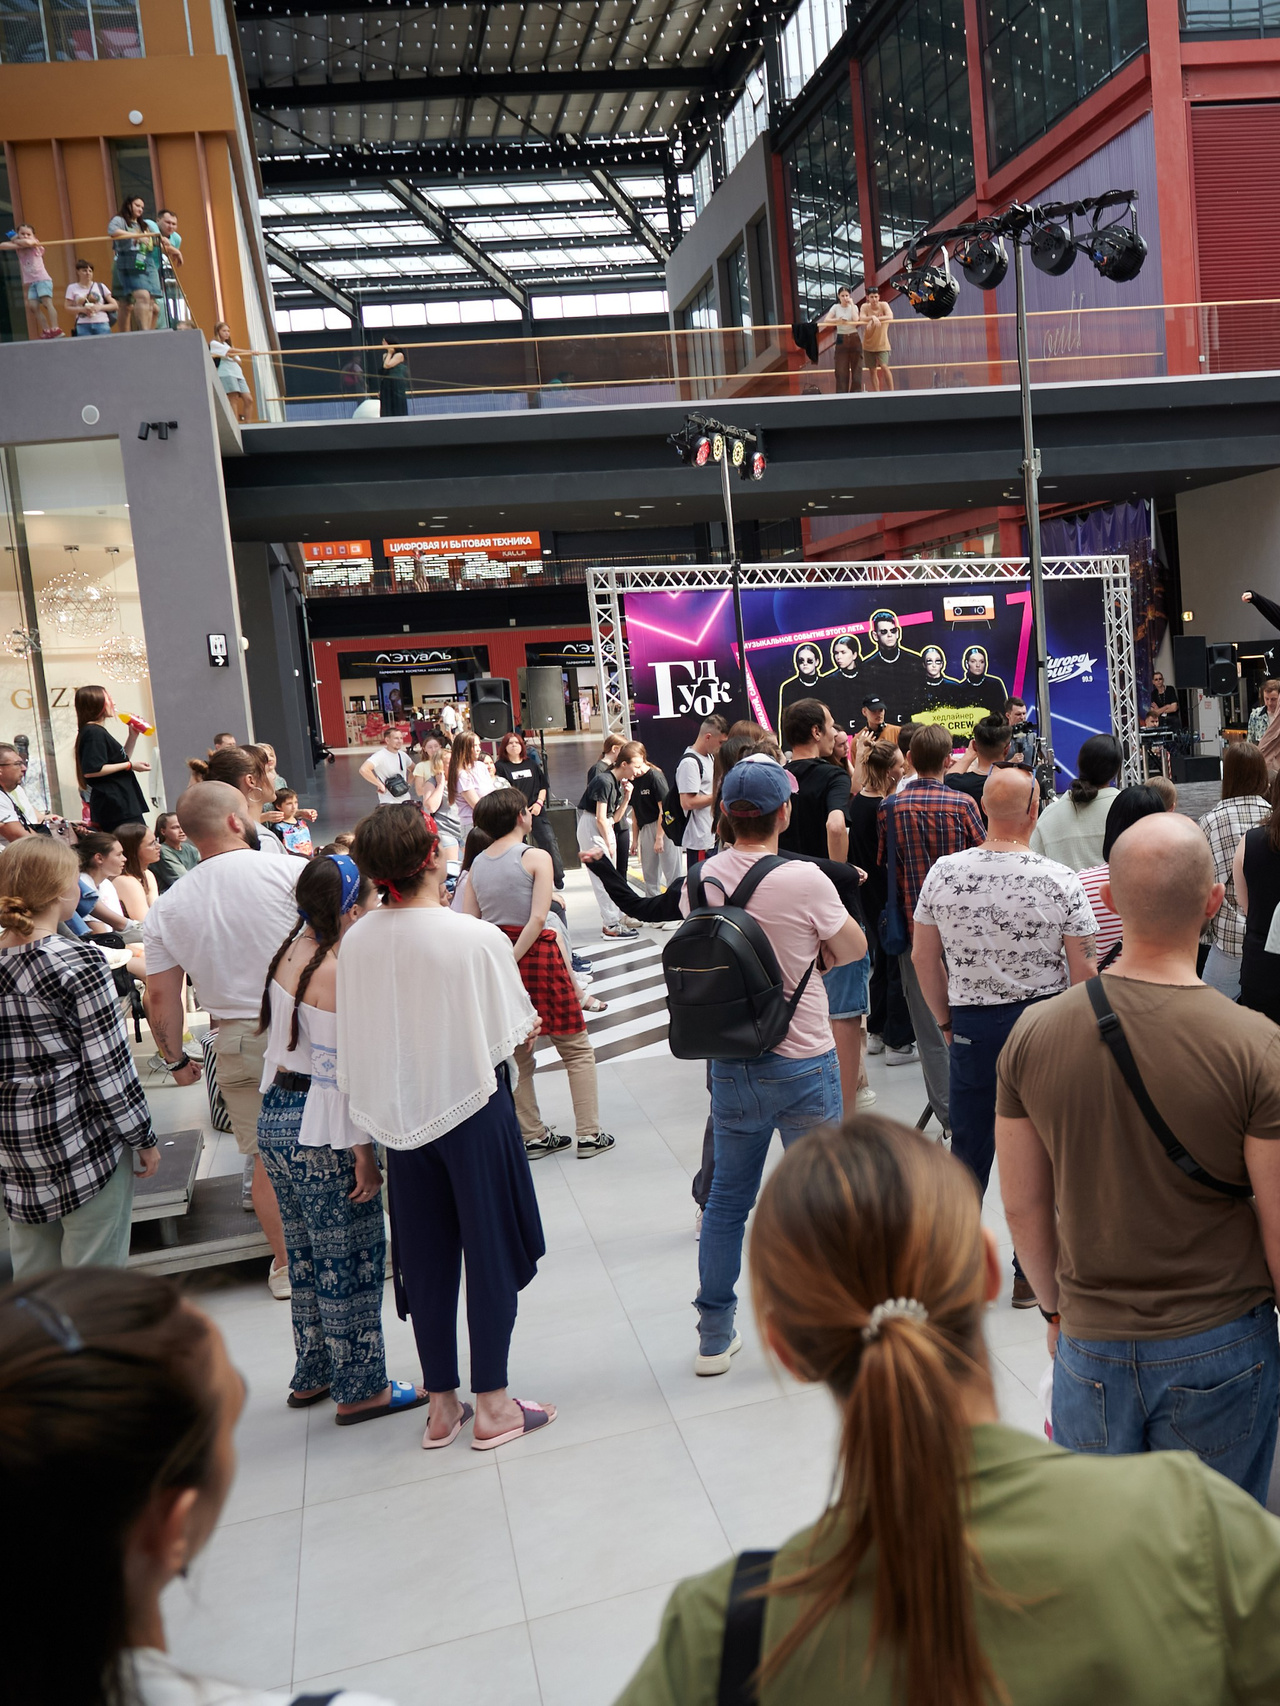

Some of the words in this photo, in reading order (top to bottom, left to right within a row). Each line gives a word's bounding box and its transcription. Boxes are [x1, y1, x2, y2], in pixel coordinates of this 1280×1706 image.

[389, 541, 440, 553] ЦИФРОВАЯ
[440, 540, 449, 549] И
[449, 537, 492, 549] БЫТОВАЯ
[492, 535, 532, 547] ТЕХНИКА
[932, 712, 975, 722] хедлайнер
[947, 720, 975, 730] CREW
